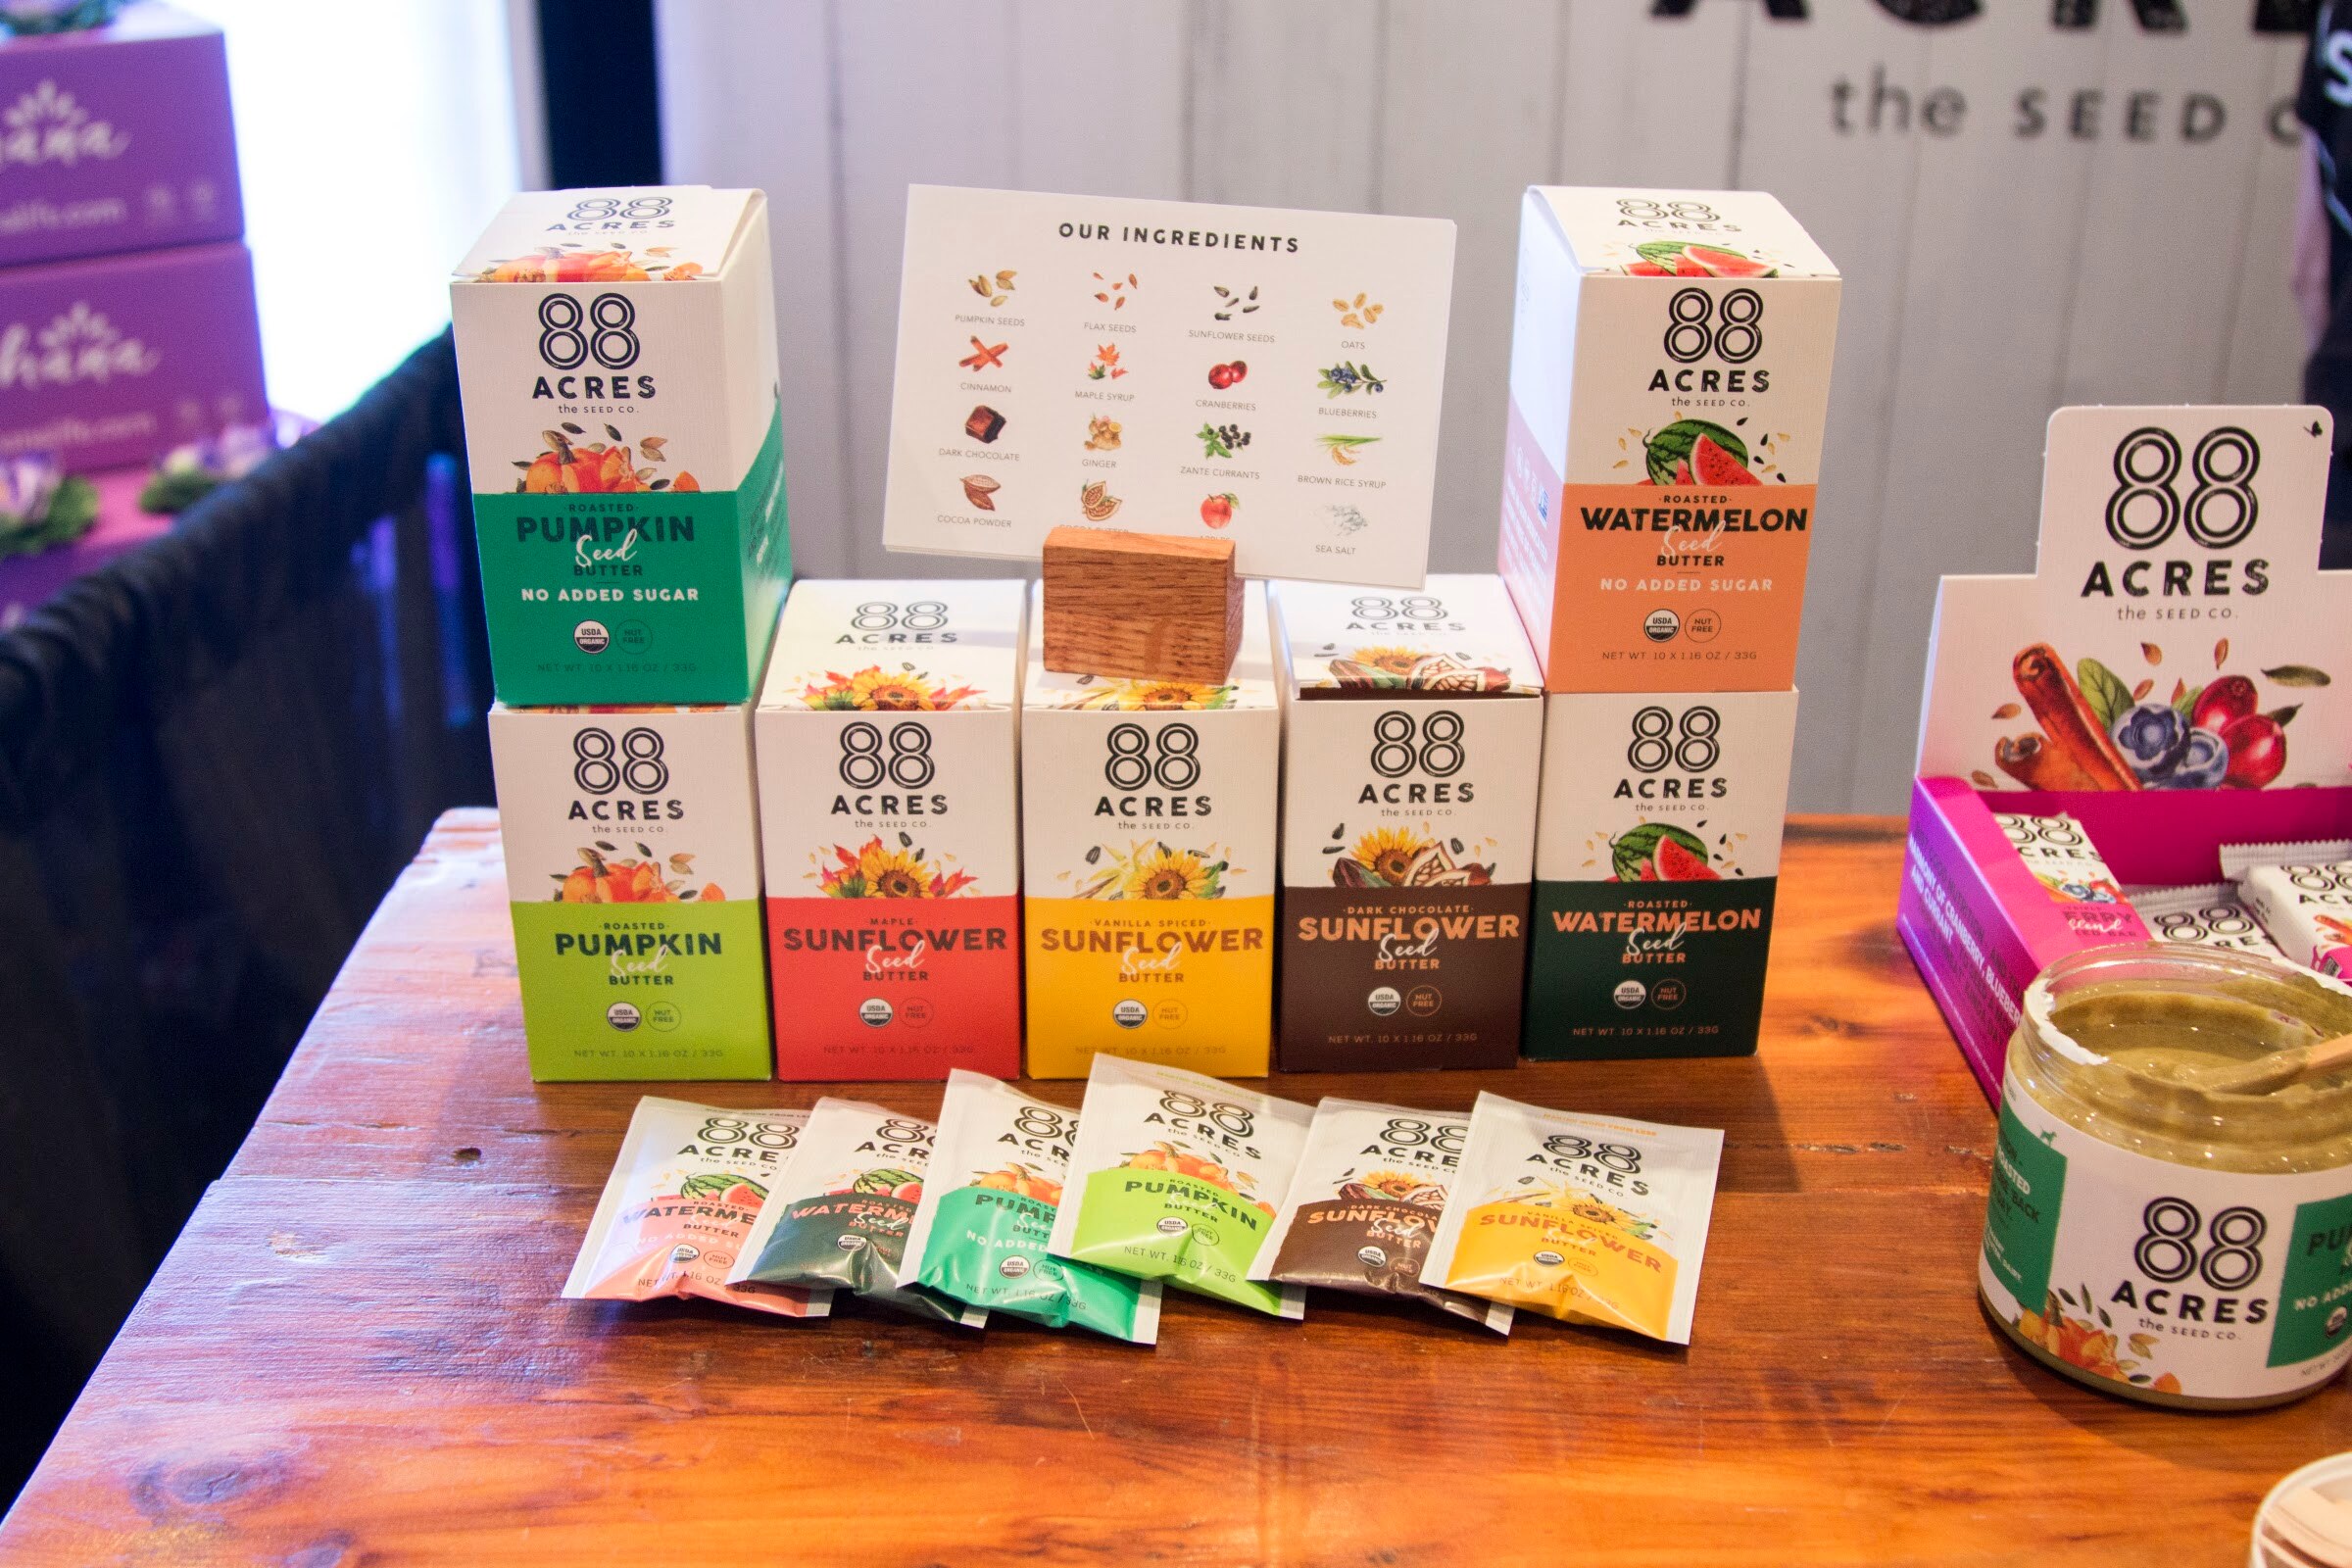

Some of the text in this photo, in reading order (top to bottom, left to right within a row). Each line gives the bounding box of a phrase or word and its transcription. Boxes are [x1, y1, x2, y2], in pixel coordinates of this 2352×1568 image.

[1832, 61, 2226, 142] the SEED
[566, 197, 672, 220] 88
[1616, 199, 1720, 222] 88
[546, 220, 674, 231] ACRES
[1617, 220, 1741, 232] ACRES
[1059, 222, 1298, 253] OUR INGREDIENTS
[539, 293, 640, 369] 88
[955, 315, 1025, 326] PUMPKIN SEEDS
[1084, 322, 1137, 333] FLAX SEEDS
[1664, 287, 1763, 364] 88
[1189, 330, 1275, 343] SUNFLOWER SEEDS
[1341, 341, 1365, 350] OATS
[532, 375, 656, 400] ACRES
[960, 382, 1011, 393] CINNAMON
[1648, 369, 1770, 393] ACRES
[1075, 391, 1135, 402] MAPLE SYRUP
[1196, 399, 1256, 412] CRANBERRIES
[1672, 397, 1690, 407] the
[559, 405, 577, 414] the
[1318, 407, 1377, 418] BLUEBERRIES
[939, 448, 1020, 462] DARK CHOCOLATE
[1082, 459, 1116, 468] GINGER
[1180, 466, 1260, 479] ZANTE CURRANTS
[1298, 475, 1387, 489] BROWN RICE SYRUP
[2105, 426, 2260, 551] 88
[568, 504, 635, 513] ROASTED
[1580, 508, 1807, 532] WATERMELON
[515, 515, 695, 543] PUMPKIN
[937, 514, 1011, 527] COCOA POWDER
[575, 528, 637, 568] Seed
[1315, 544, 1356, 555] SEA SALT
[1661, 520, 1726, 559] Seed
[573, 564, 643, 576] BUTTER
[1656, 556, 1724, 566] BUTTER
[1600, 578, 1772, 591] NO ADDED SUGAR
[2081, 559, 2270, 597] ACRES
[521, 589, 699, 602] NO ADDED SUGAR
[851, 602, 949, 631] 88
[1351, 597, 1448, 620] 88
[2117, 607, 2238, 620] the SEED CO.
[835, 632, 957, 644] ACRES
[1347, 622, 1466, 631] ACRES
[1371, 710, 1465, 778] 88
[1628, 706, 1721, 773] 88
[573, 727, 668, 795] 88
[839, 721, 935, 789] 88
[1104, 723, 1200, 791] 88
[1357, 783, 1475, 804] ACRES
[1614, 778, 1727, 799] ACRES
[568, 800, 684, 820] ACRES
[831, 795, 949, 814] ACRES
[1094, 796, 1212, 816] ACRES
[1118, 820, 1136, 830] the
[1390, 906, 1470, 914] CHOCOLATE
[1552, 908, 1760, 933] WATERMELON
[1298, 914, 1519, 941] SUNFLOWER
[2154, 907, 2254, 942] 88
[555, 933, 721, 956] PUMPKIN
[784, 928, 1007, 951] SUNFLOWER
[1041, 928, 1263, 954] SUNFLOWER
[1379, 928, 1439, 962] Seed
[1627, 921, 1687, 956] Seed
[611, 945, 668, 978] Seed
[865, 940, 925, 973] Seed
[1121, 942, 1182, 975] Seed
[1375, 959, 1440, 970] BUTTER
[1622, 953, 1687, 963] BUTTER
[609, 975, 673, 985] BUTTER
[862, 971, 928, 981] BUTTER
[1119, 973, 1184, 983] BUTTER
[1159, 1090, 1254, 1138] 88
[698, 1118, 800, 1149] 88
[1144, 1113, 1261, 1159] ACRES
[1543, 1135, 1642, 1174] 88
[1527, 1153, 1649, 1196] ACRES
[1125, 1181, 1257, 1231] PUMPKIN
[1164, 1203, 1218, 1223] BUTTER
[683, 1224, 739, 1239] BUTTER
[966, 1231, 987, 1245] NO
[1480, 1214, 1661, 1274] SUNFLOWER
[1541, 1237, 1597, 1256] BUTTER
[2134, 1197, 2267, 1292] 88
[1125, 1246, 1147, 1255] NET
[1215, 1268, 1237, 1283] 33G
[2111, 1280, 2269, 1324] ACRES
[2139, 1316, 2164, 1333] the
[2172, 1326, 2211, 1339] SEED
